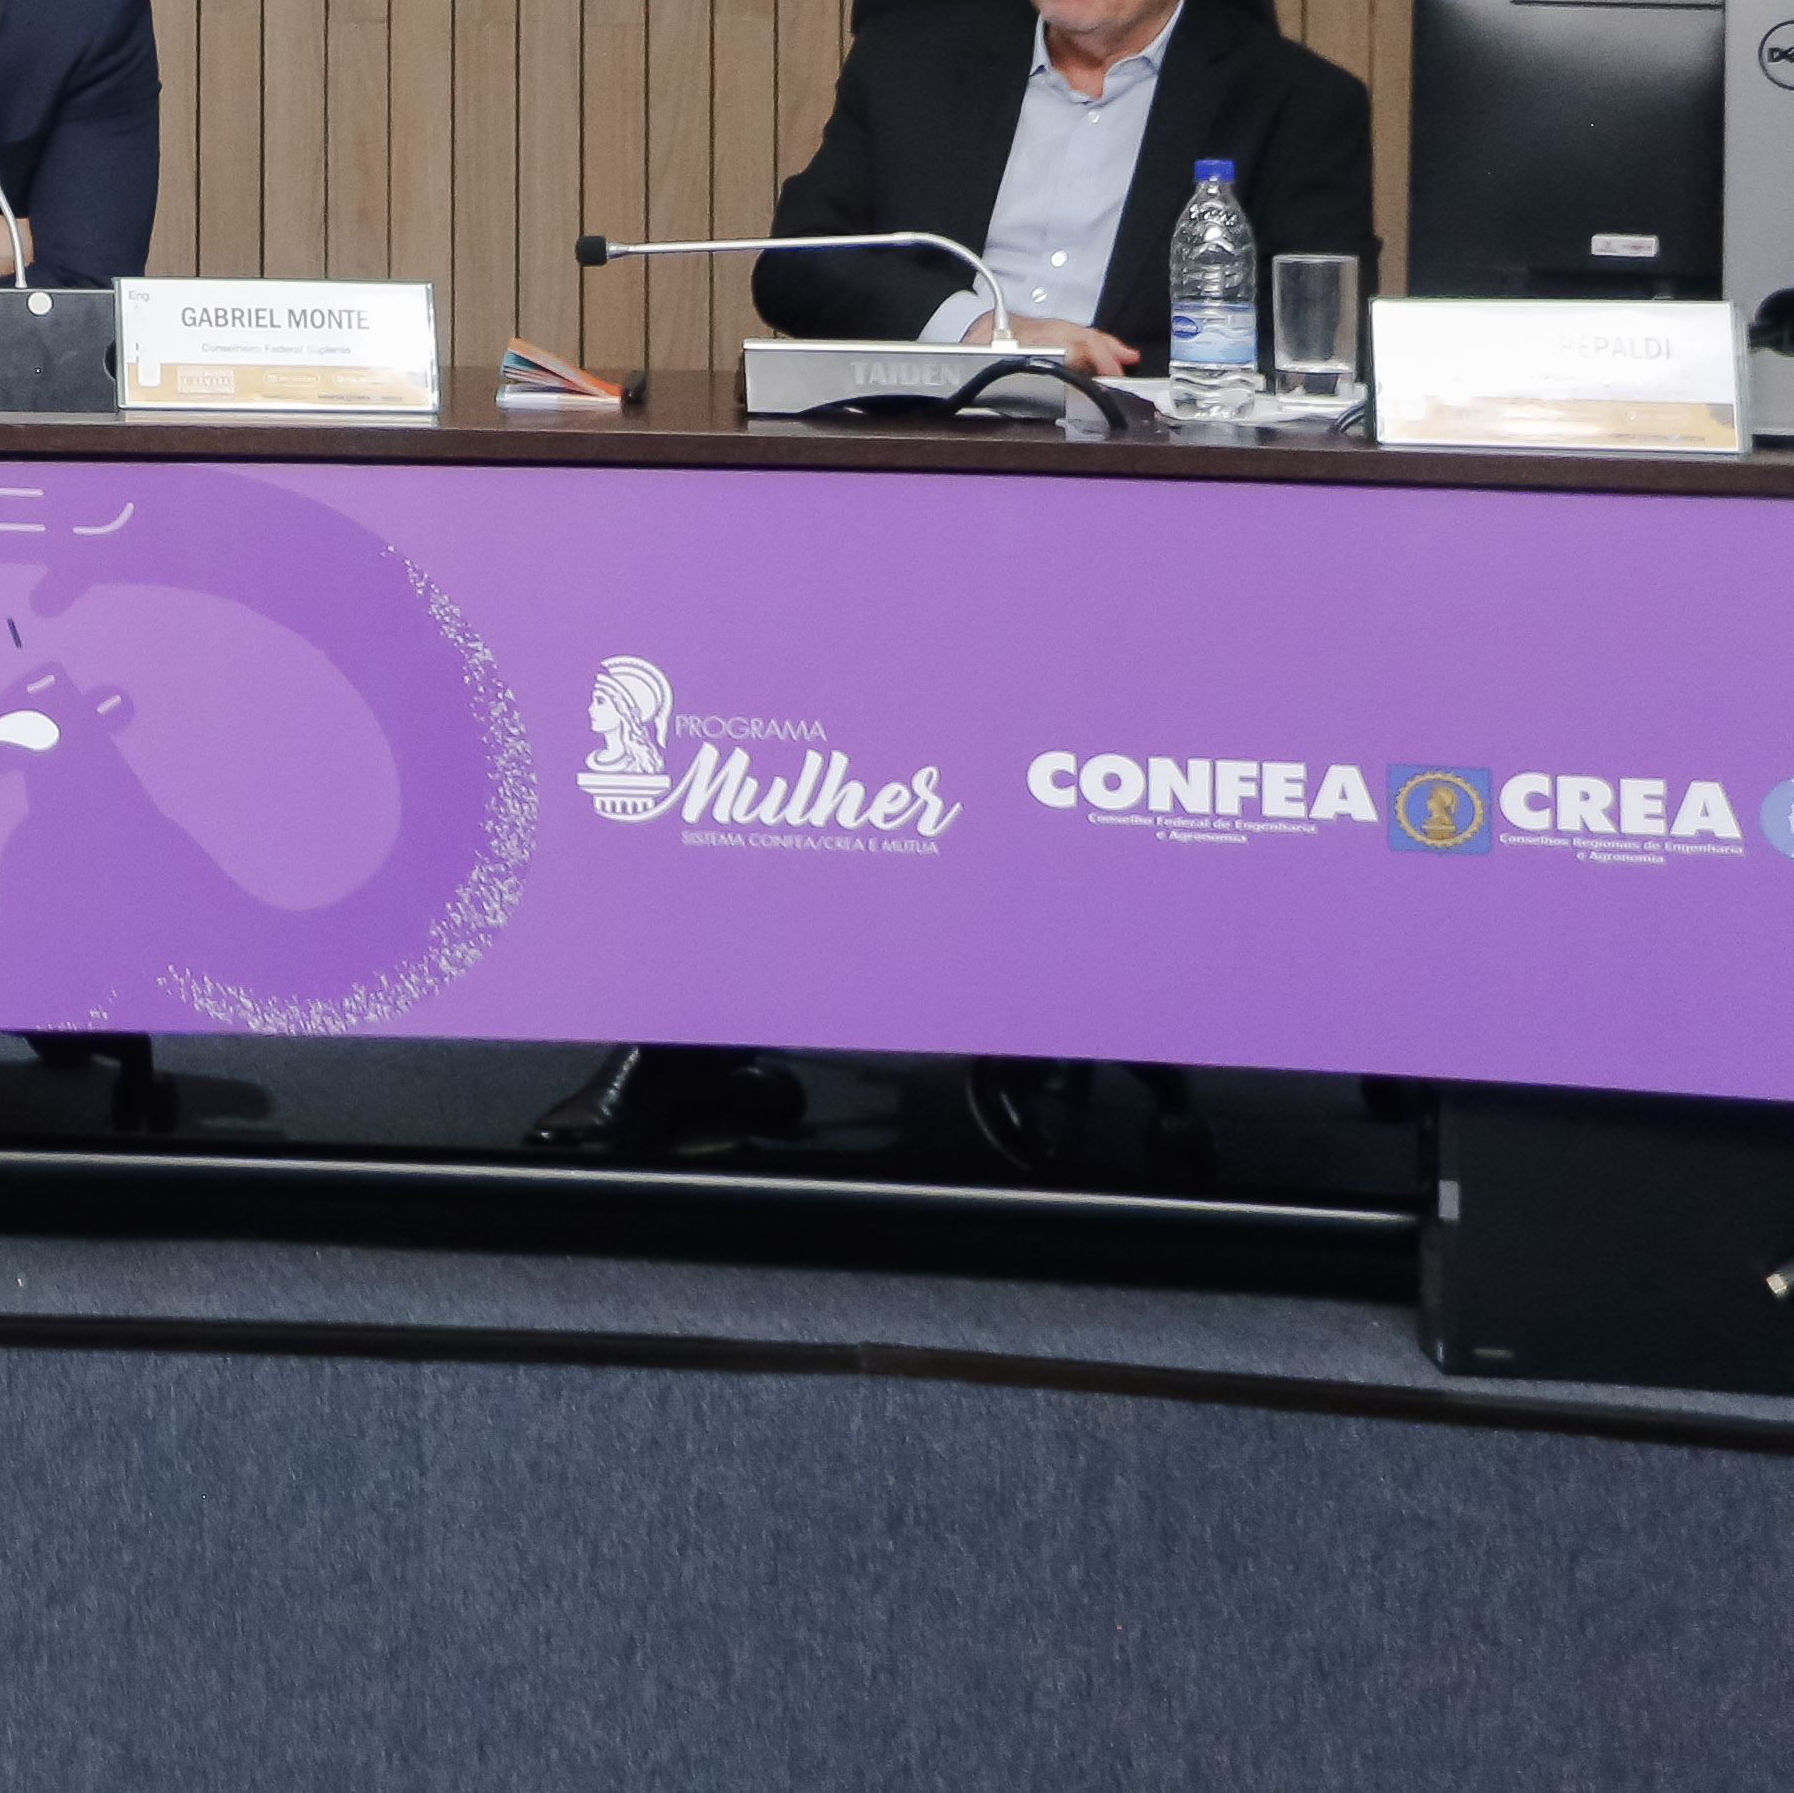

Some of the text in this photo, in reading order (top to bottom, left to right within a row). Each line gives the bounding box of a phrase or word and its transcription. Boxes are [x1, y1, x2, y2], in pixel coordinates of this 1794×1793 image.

[181, 307, 370, 330] GABRIEL MONTE
[675, 714, 828, 742] PROGRAMA
[667, 740, 963, 837] Mulher
[1026, 750, 1379, 823] CONFEA
[1499, 771, 1743, 840] CREA
[1499, 832, 1570, 847] Conselhos
[1589, 849, 1665, 865] Agronomia
